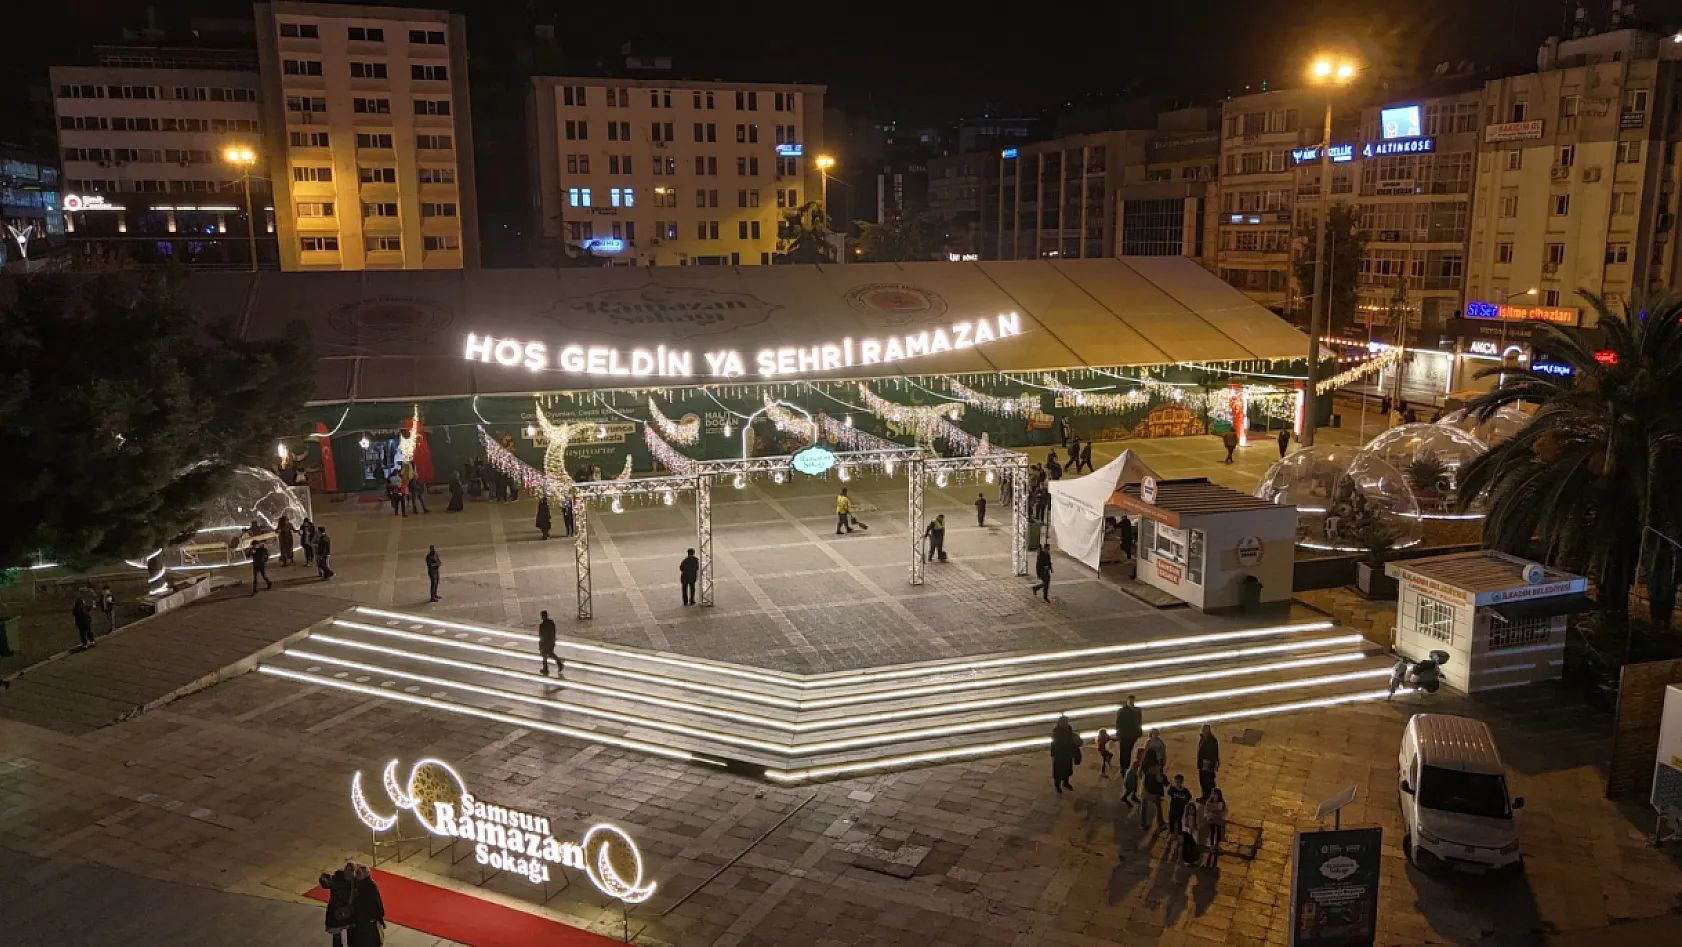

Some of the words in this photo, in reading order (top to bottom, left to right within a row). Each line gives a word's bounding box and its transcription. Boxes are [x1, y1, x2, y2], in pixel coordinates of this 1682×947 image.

[465, 333, 546, 371] HOŞ
[560, 344, 691, 376] GELDİN
[705, 351, 744, 376] YA
[757, 337, 852, 377] ŞEHRİ
[862, 312, 1019, 364] RAMAZAN
[434, 802, 586, 870] Ramazan
[461, 793, 550, 835] Samsun
[475, 843, 550, 883] Sokağı
